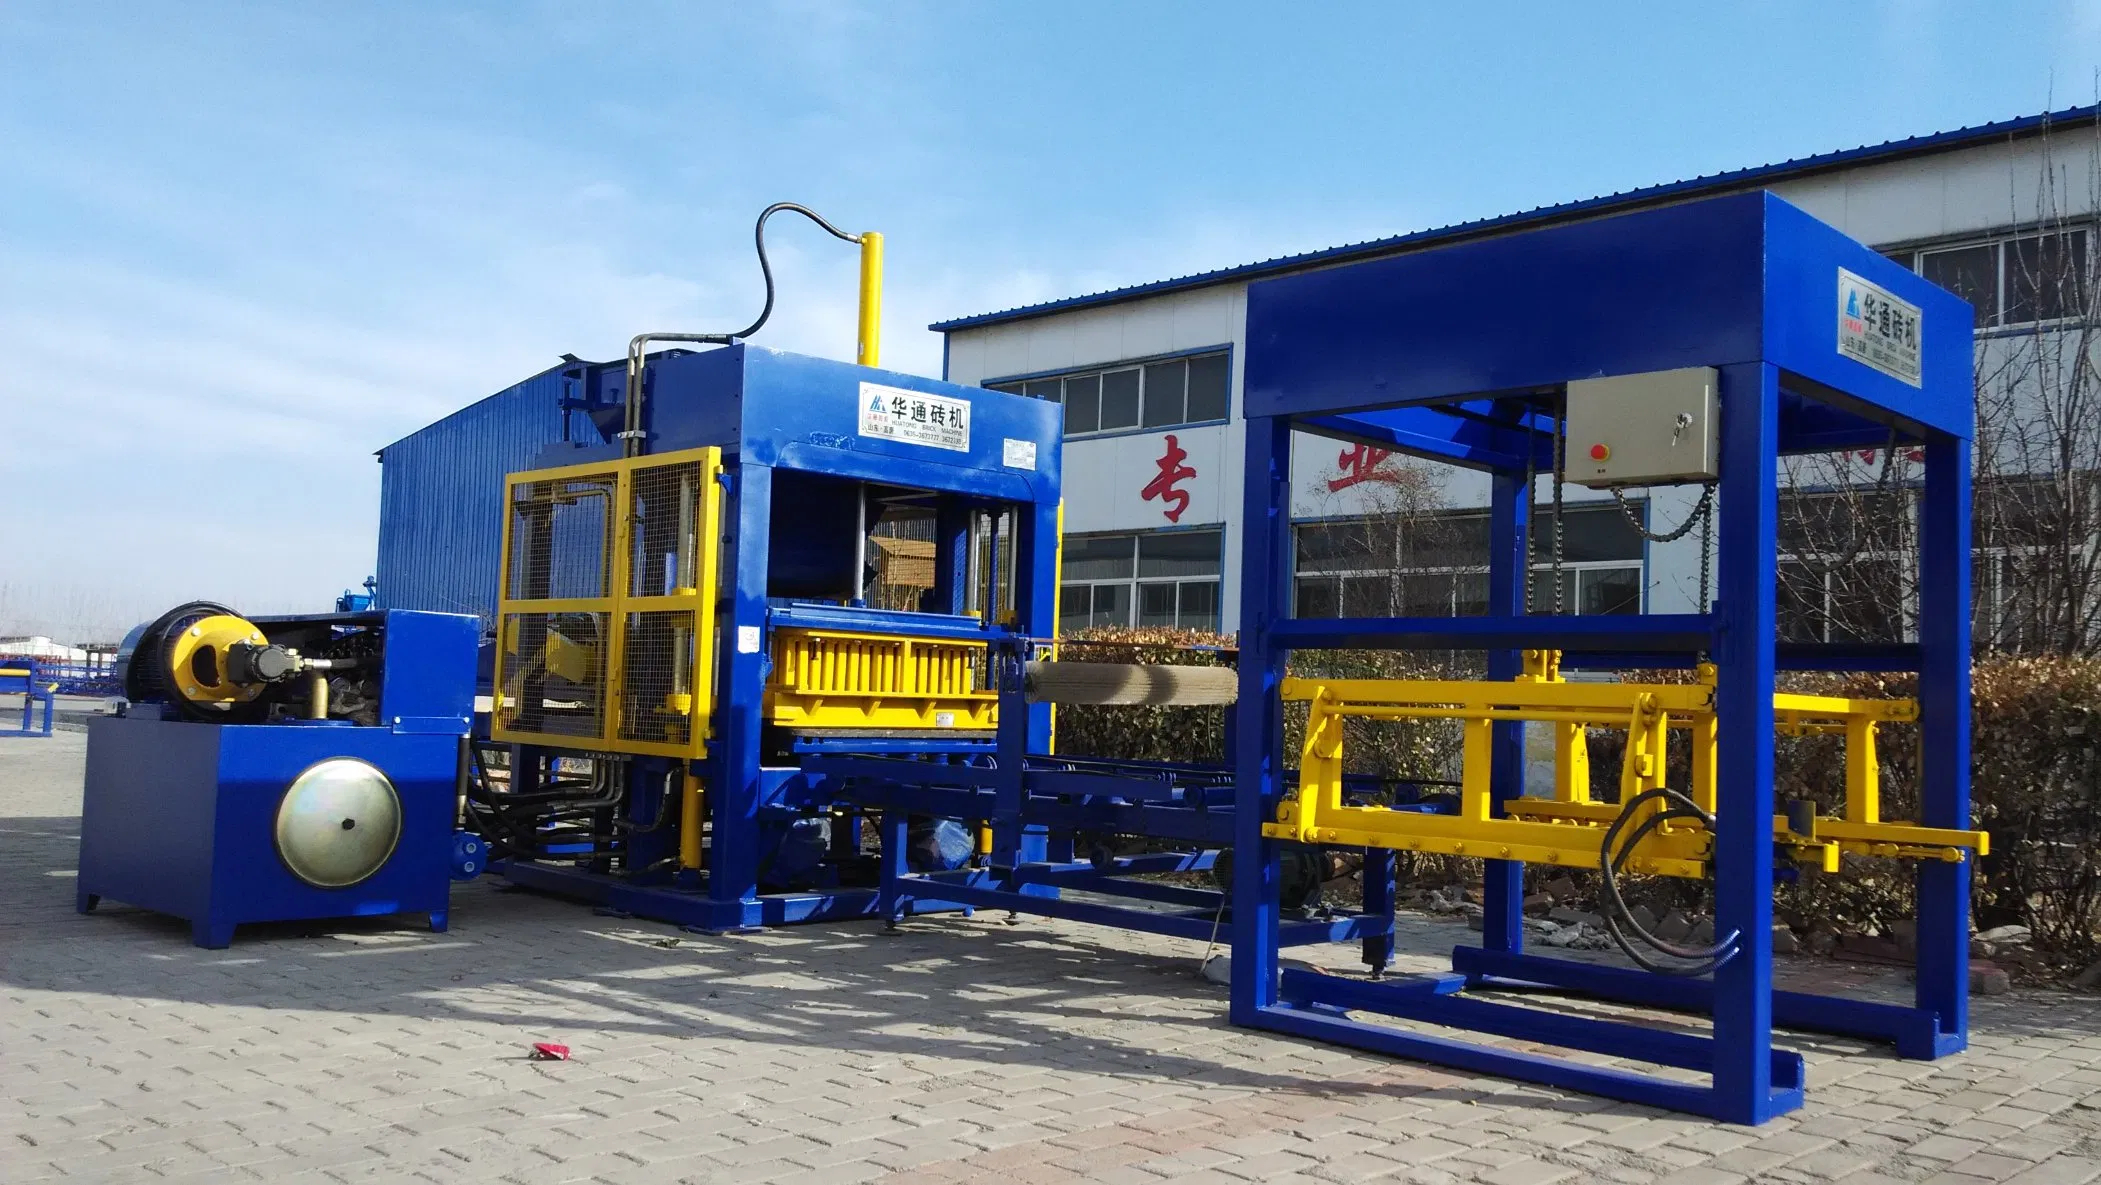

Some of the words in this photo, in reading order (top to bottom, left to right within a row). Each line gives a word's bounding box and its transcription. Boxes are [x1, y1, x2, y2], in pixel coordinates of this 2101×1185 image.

[1864, 293, 1917, 350] 华通砖机
[891, 396, 964, 429] 华通砖机
[922, 424, 936, 433] BRICK
[1141, 434, 1197, 523] 专
